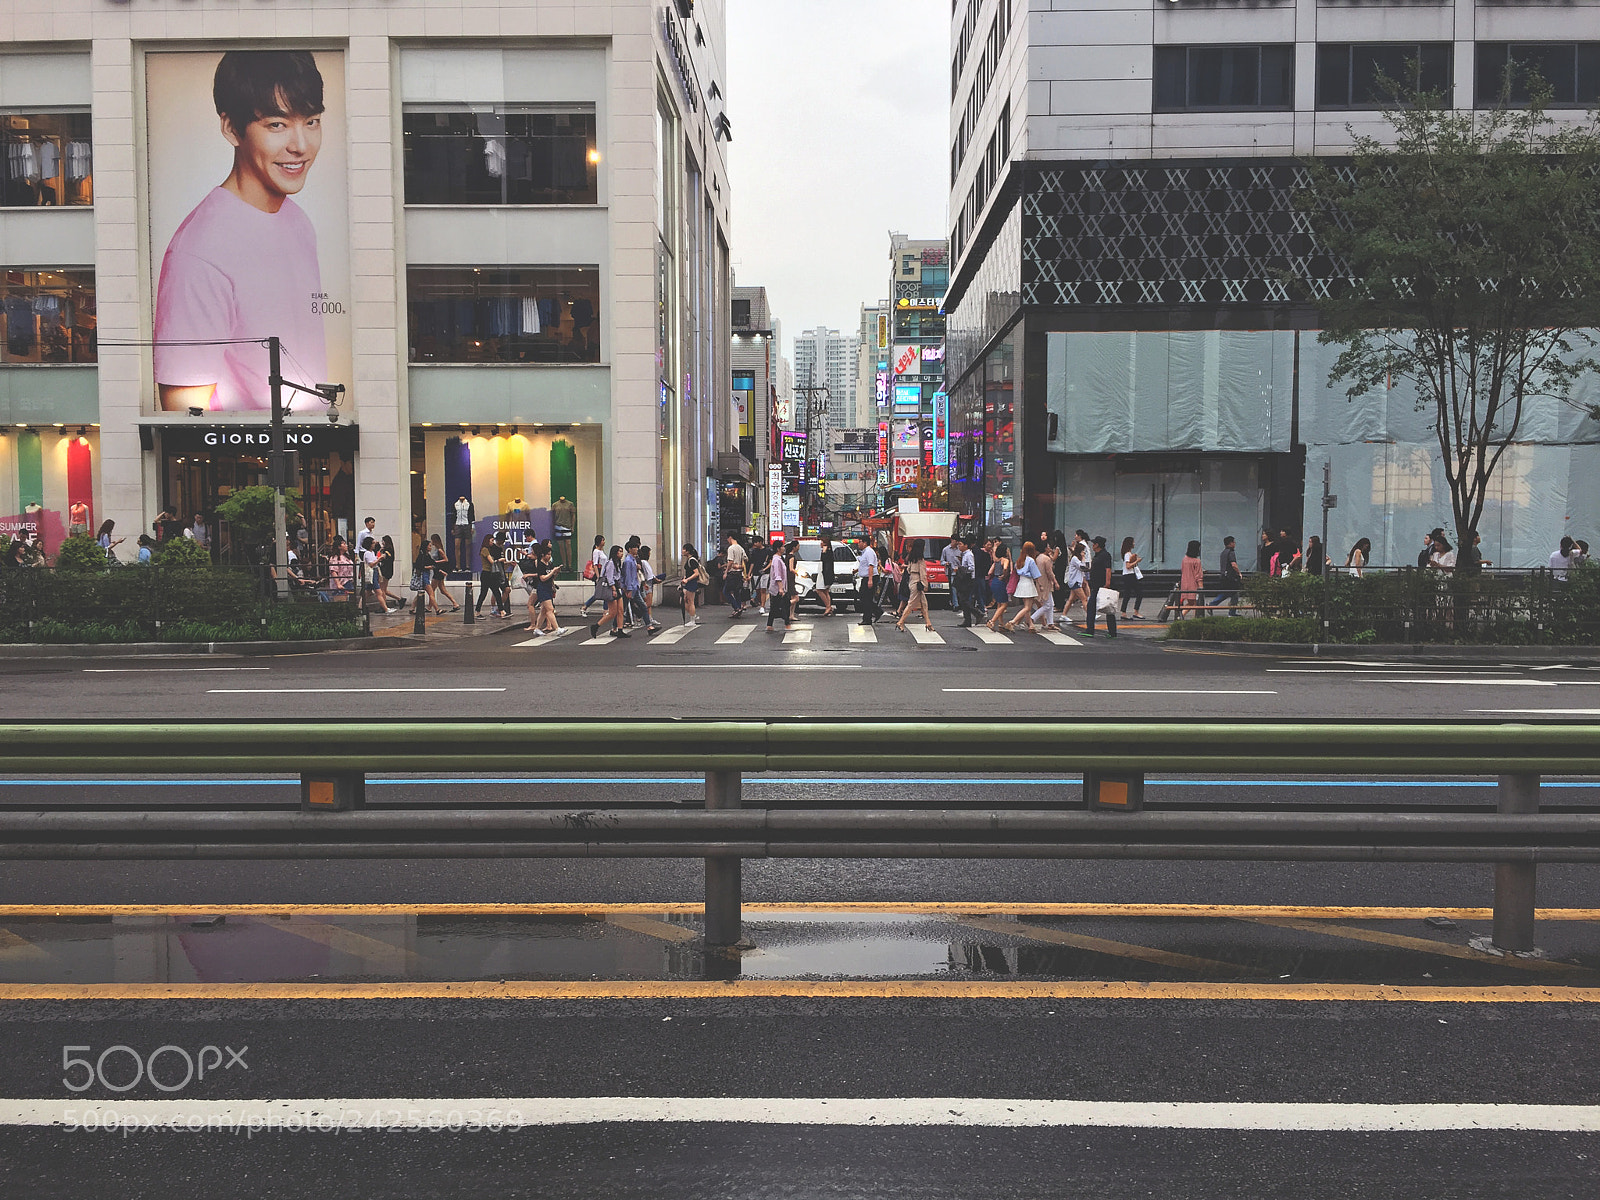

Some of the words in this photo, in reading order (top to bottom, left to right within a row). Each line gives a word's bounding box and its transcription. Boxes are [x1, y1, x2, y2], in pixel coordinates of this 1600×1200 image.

[204, 432, 313, 445] GIORDNO
[895, 459, 919, 467] ROOM
[0, 522, 37, 531] SUMMER
[492, 521, 531, 530] SUMMER
